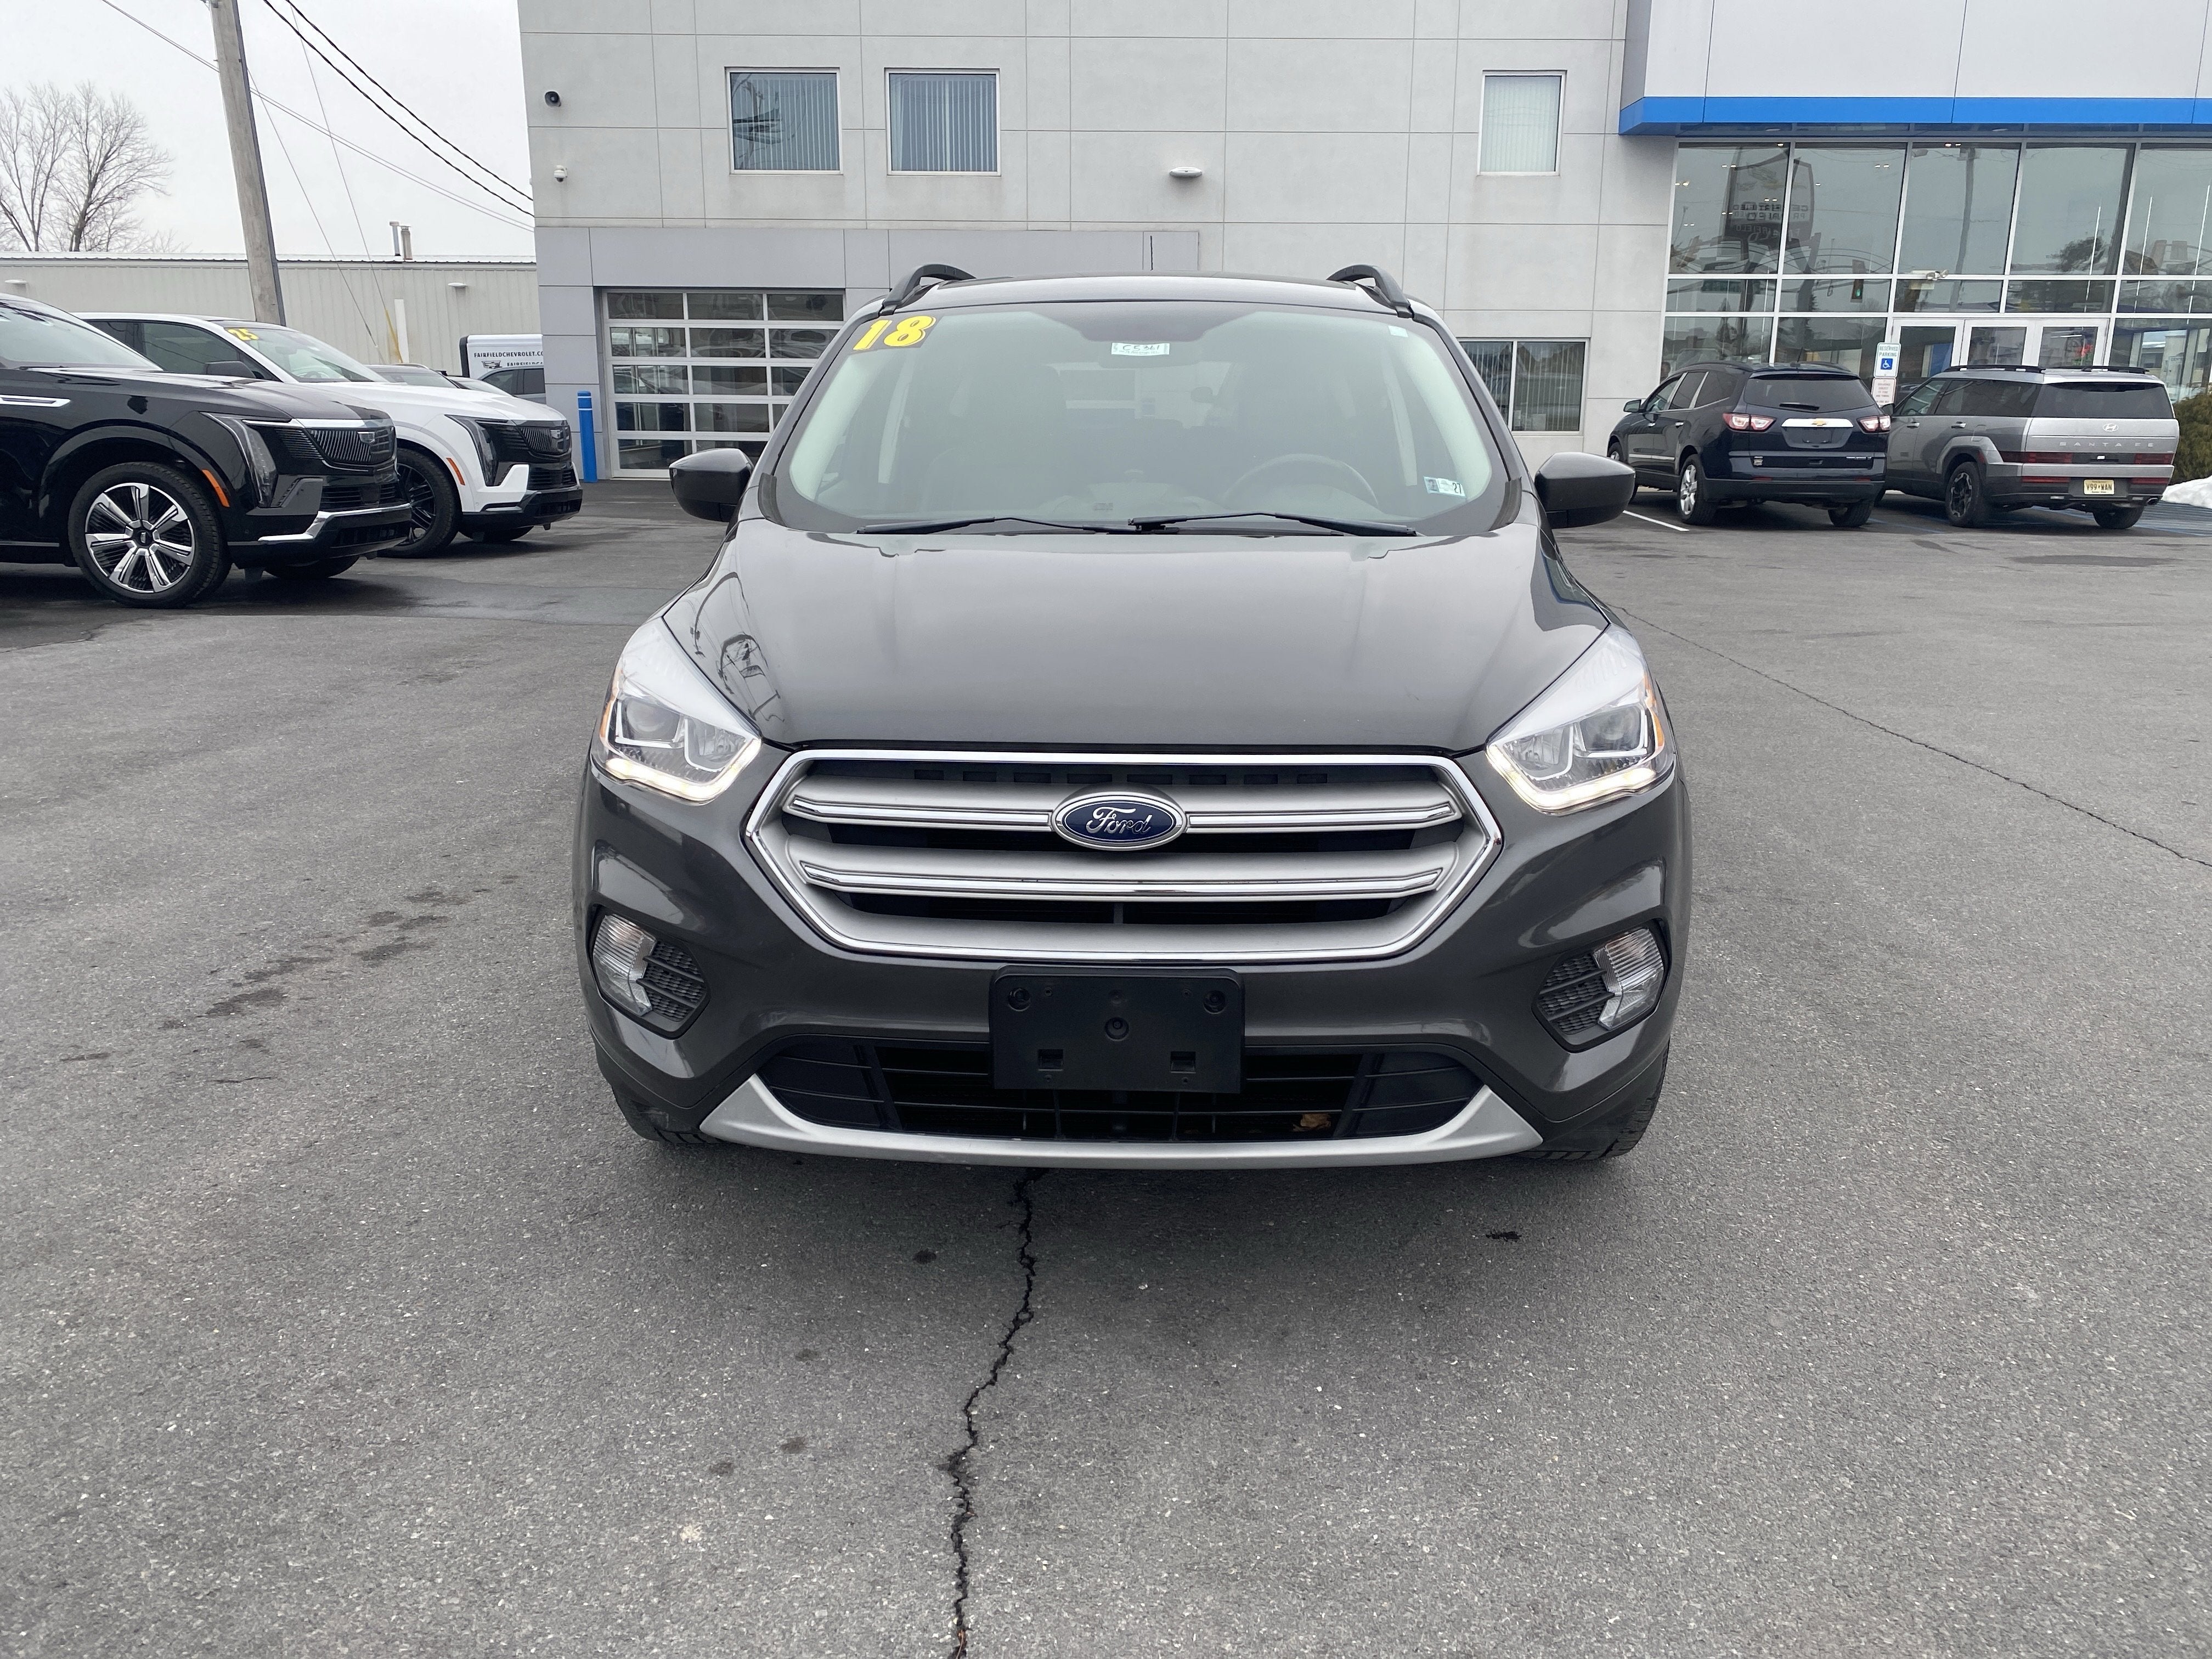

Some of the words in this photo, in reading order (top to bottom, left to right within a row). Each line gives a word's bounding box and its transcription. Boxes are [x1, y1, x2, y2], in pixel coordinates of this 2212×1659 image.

[228, 328, 259, 340] 25
[853, 315, 936, 351] 18
[1086, 806, 1153, 834] Ford
